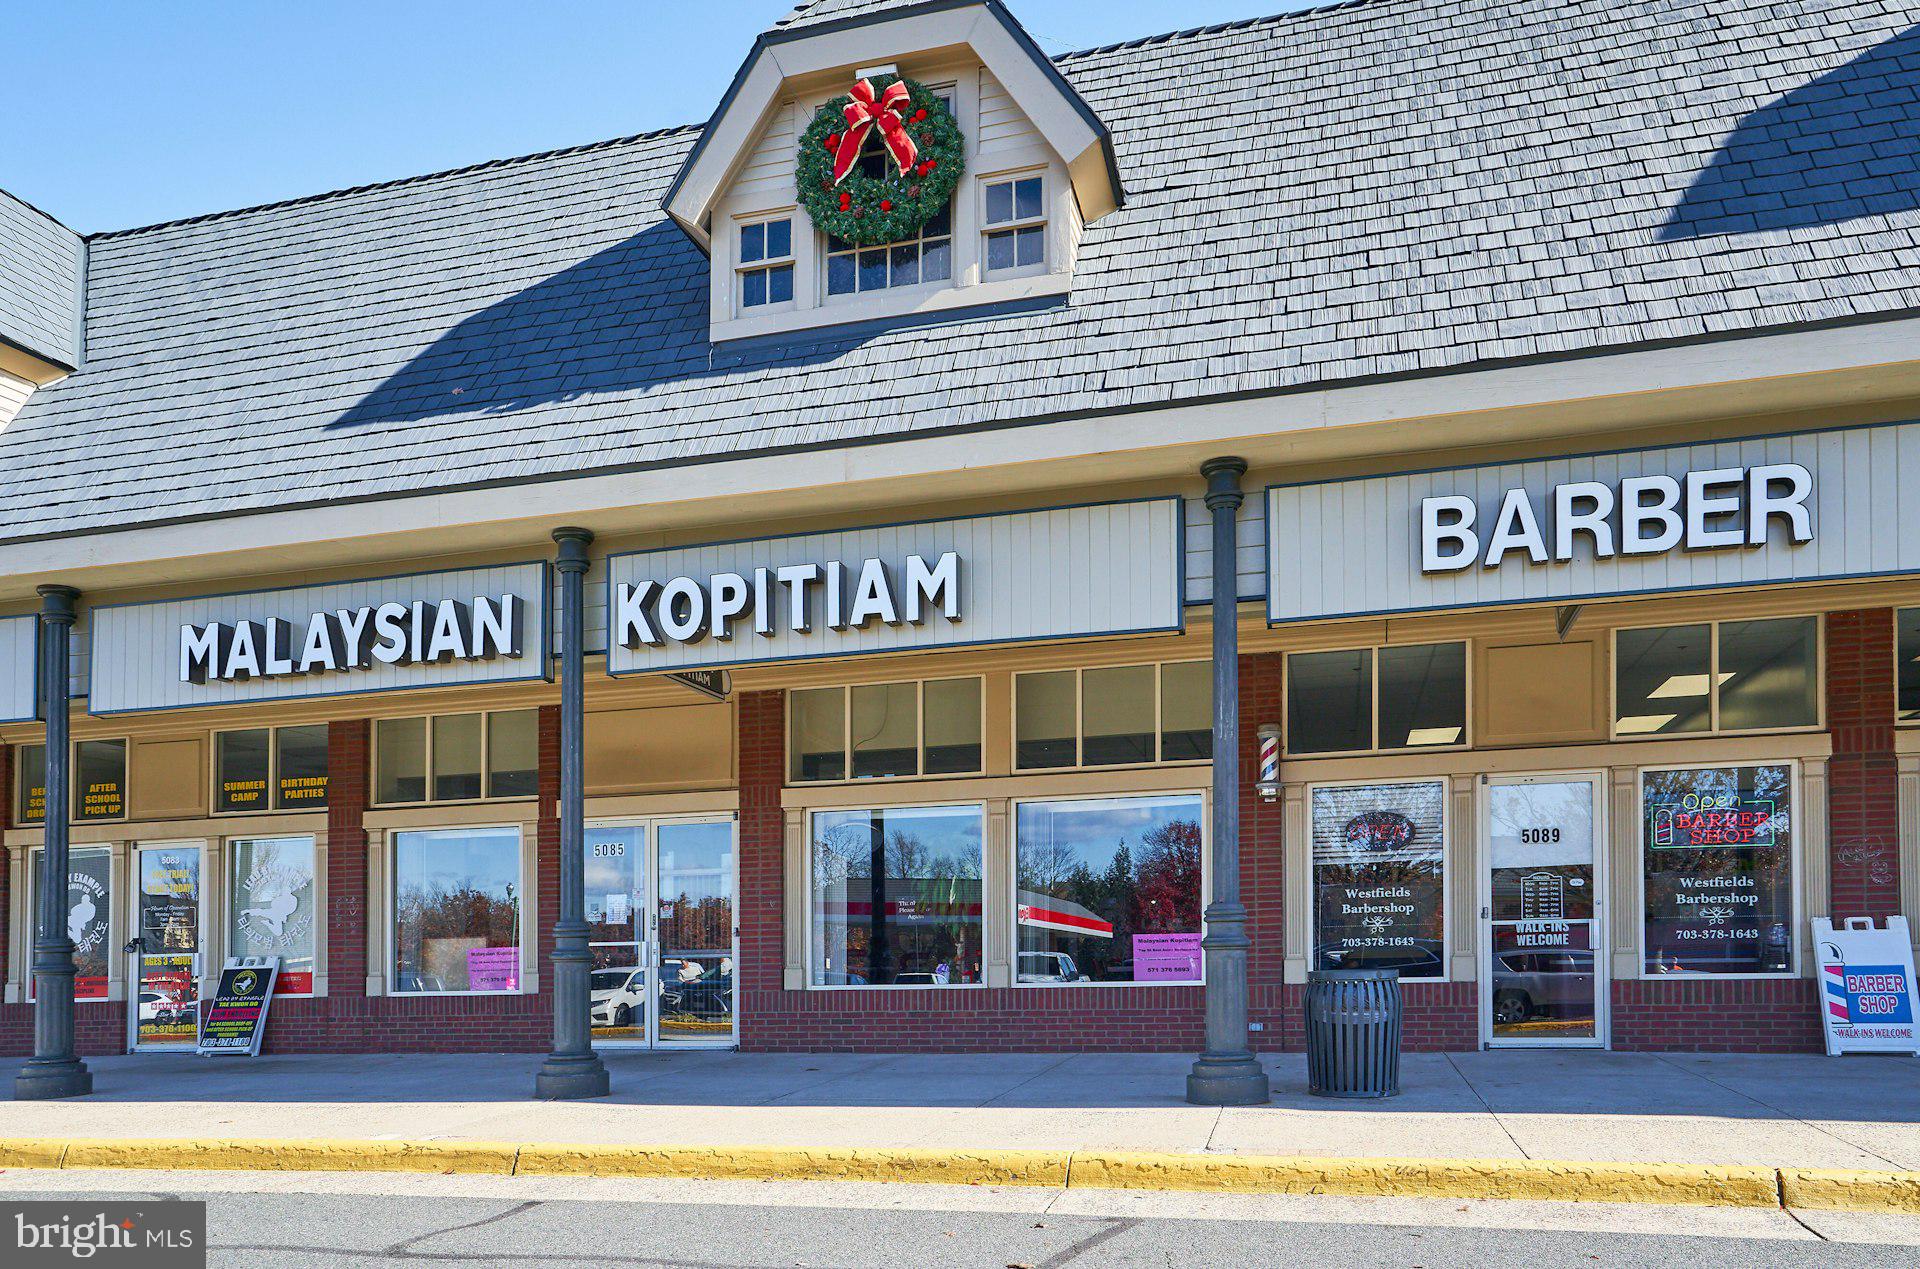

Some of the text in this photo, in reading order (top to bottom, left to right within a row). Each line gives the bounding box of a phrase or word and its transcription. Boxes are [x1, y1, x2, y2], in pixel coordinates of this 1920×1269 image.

[1421, 463, 1814, 572] BARBER
[616, 551, 963, 649] KOPITIAM
[179, 593, 524, 683] MALAYSIAN
[89, 783, 117, 793] AFTER
[223, 780, 266, 791] SUMMER
[280, 777, 329, 788] BIRTHDAY
[31, 787, 46, 797] BEF
[231, 792, 259, 802] CAMP
[284, 788, 325, 799] PARTIES
[85, 794, 121, 804] SCHOOL
[1683, 793, 1740, 813] Open
[27, 809, 46, 818] DRO
[85, 804, 121, 815] PICK UP
[1675, 812, 1771, 829] BARBER
[1350, 823, 1411, 840] OPEN
[1521, 828, 1560, 843] 5089
[1690, 829, 1756, 845] SHOP
[594, 843, 624, 857] 5085
[74, 872, 105, 899] EXAMPLE
[1680, 876, 1754, 888] Westfields
[1345, 887, 1411, 899] Westfields
[1675, 893, 1759, 907] Barbershop
[1342, 903, 1415, 915] Barbershop
[1515, 922, 1570, 933] WALK-INS
[1516, 933, 1570, 946] WELCOME
[1675, 929, 1759, 940] 703-378-1643
[1341, 936, 1415, 947] 703-378-1643
[144, 956, 162, 966] AGES
[163, 957, 168, 965] 3
[1846, 974, 1906, 994] BARBER
[1858, 995, 1898, 1014] SHOP
[1874, 1028, 1913, 1038] WELCOME
